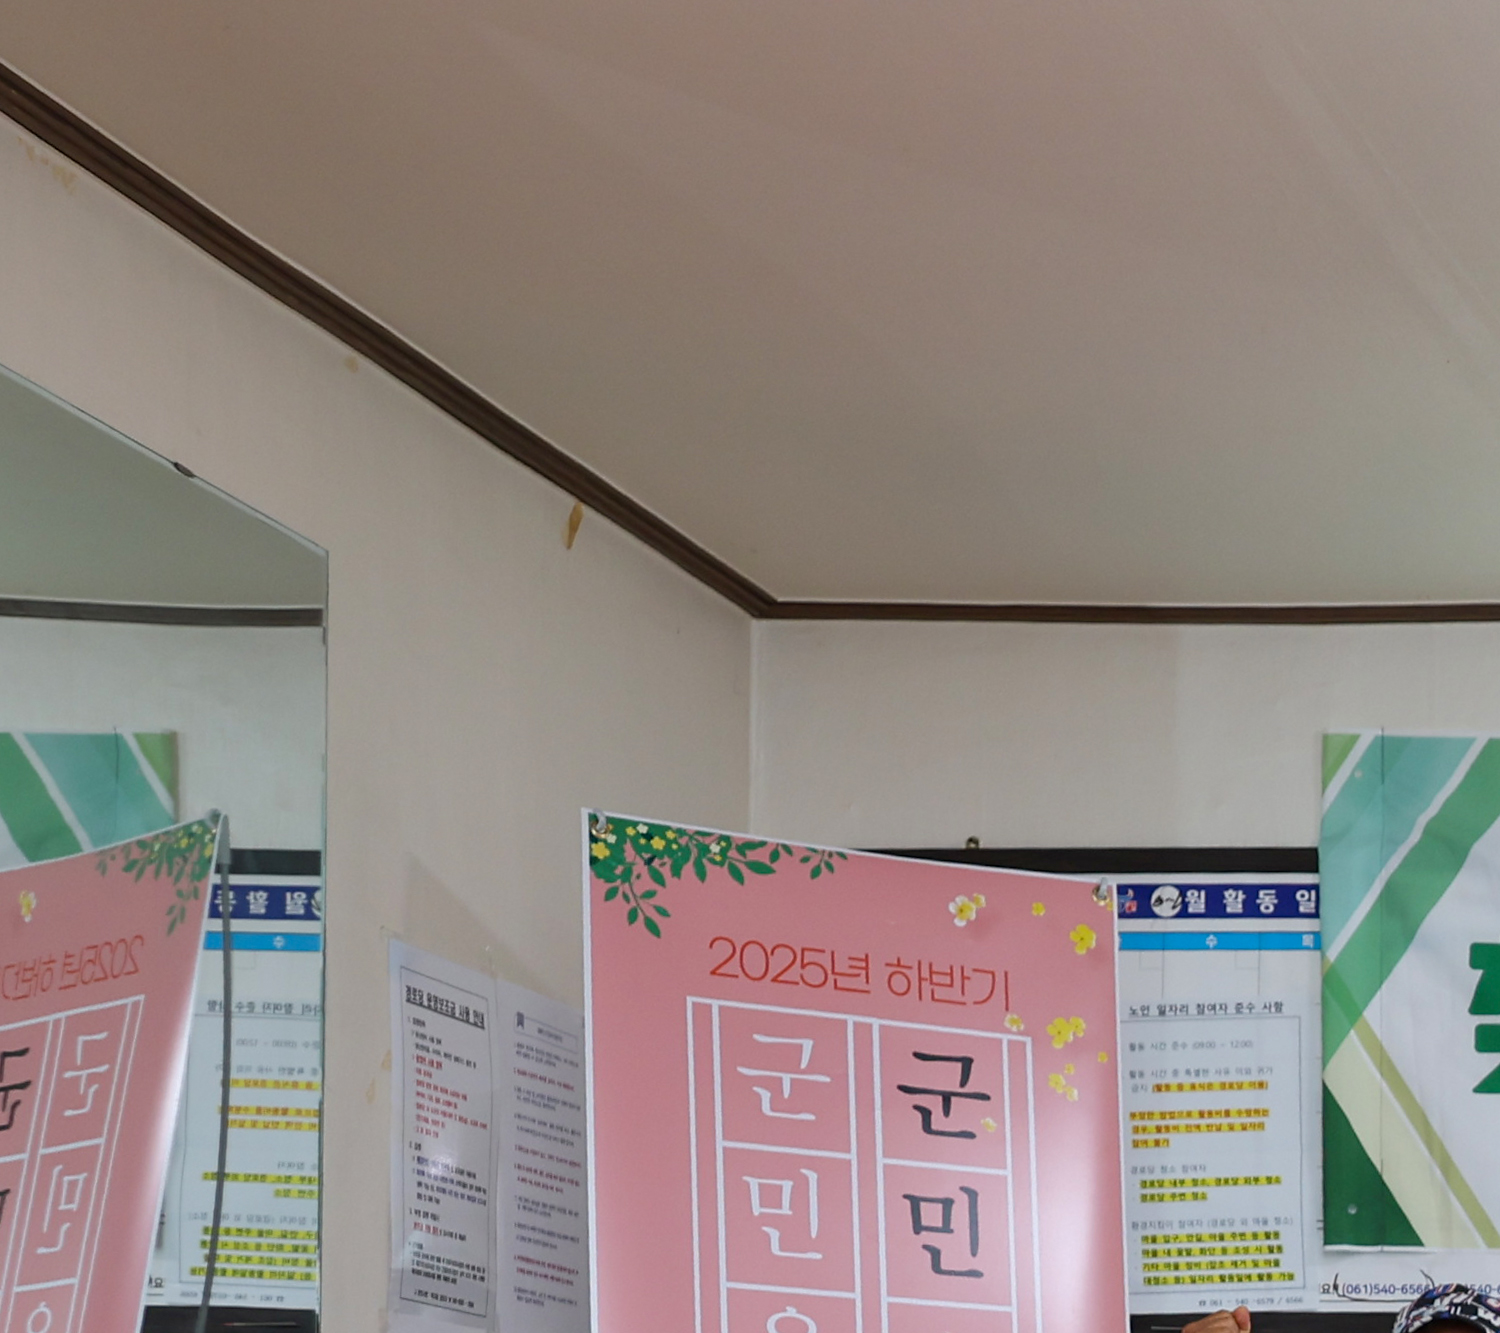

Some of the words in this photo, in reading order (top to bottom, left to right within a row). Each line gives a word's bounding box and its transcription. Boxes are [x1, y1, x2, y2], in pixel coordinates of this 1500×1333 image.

[1185, 889, 1206, 914] 월
[1295, 889, 1316, 914] 일
[1205, 934, 1218, 949] 수
[708, 936, 873, 995] 2025년
[884, 956, 1012, 1013] 하반기
[1157, 1003, 1189, 1016] 일자리
[1196, 1003, 1228, 1014] 참여자
[1234, 1002, 1256, 1013] 준수
